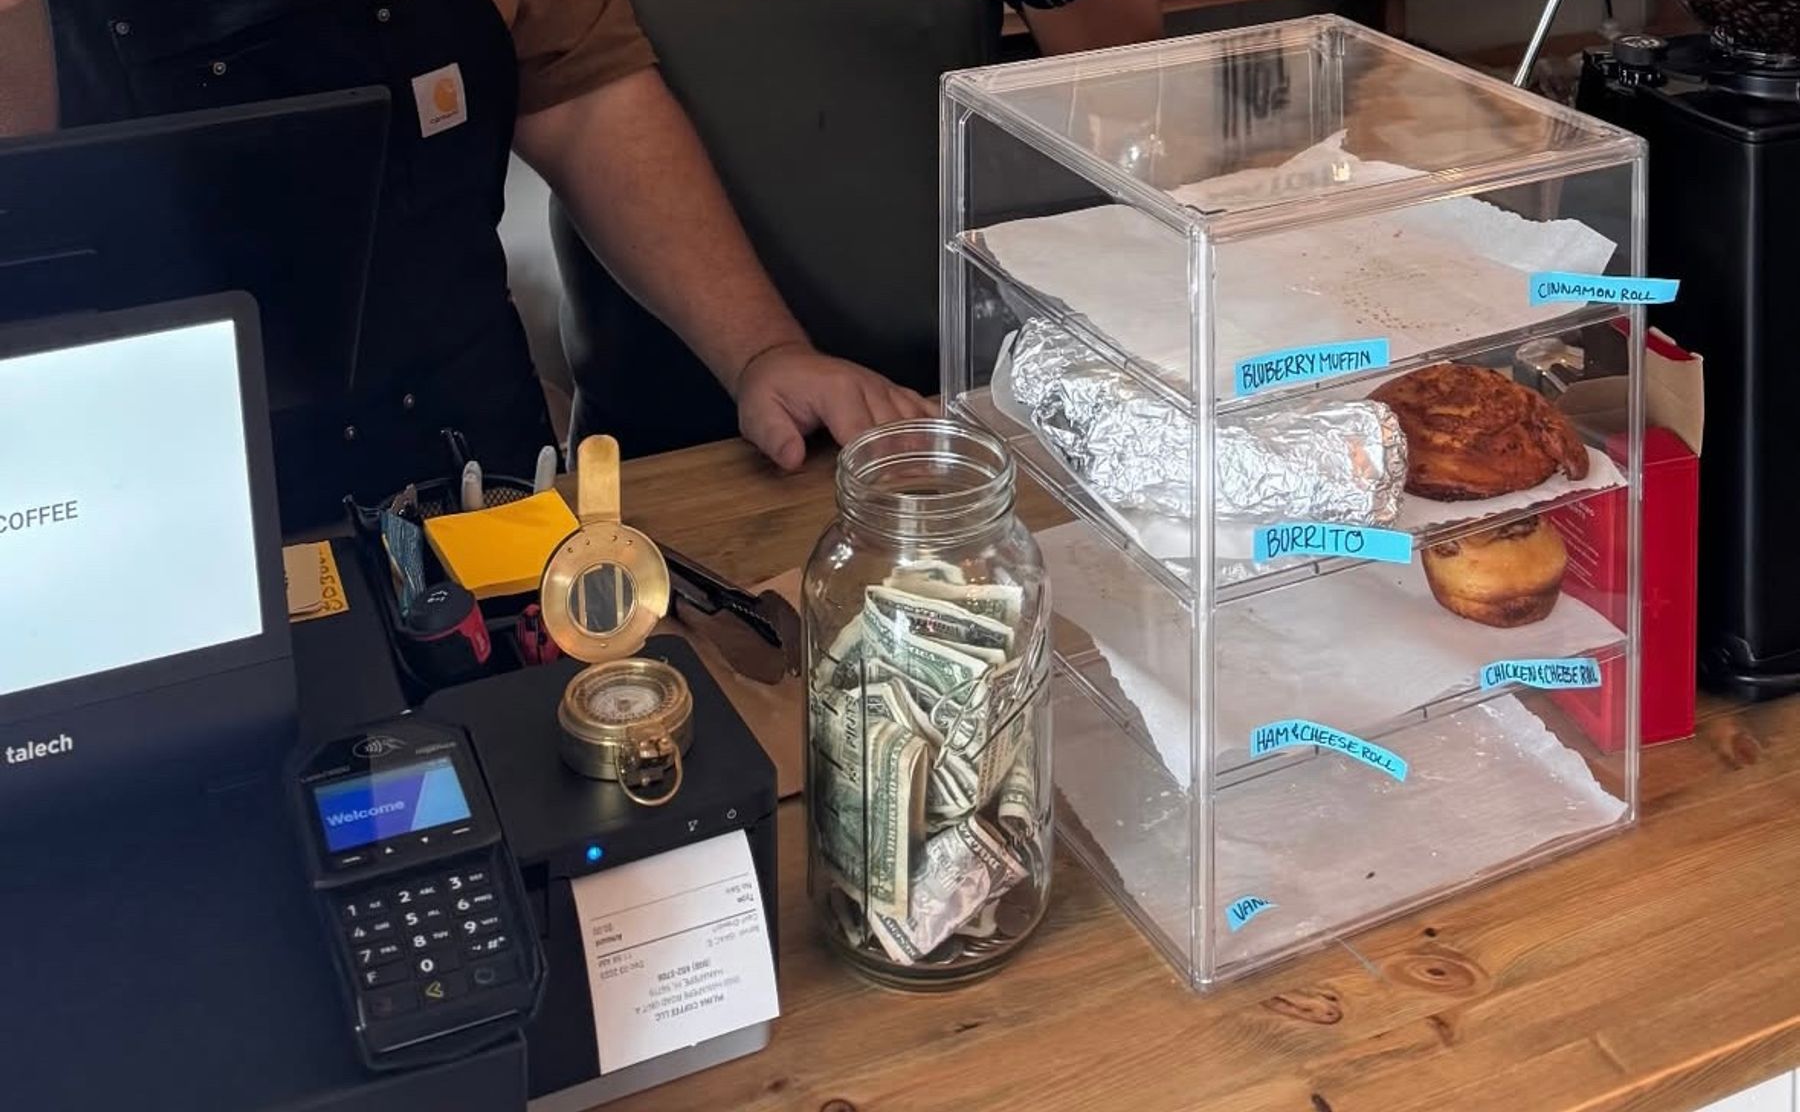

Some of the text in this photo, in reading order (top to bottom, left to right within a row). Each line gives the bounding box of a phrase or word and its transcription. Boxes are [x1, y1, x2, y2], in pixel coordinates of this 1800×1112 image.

[1537, 282, 1657, 302] CINNAMON ROLL
[1318, 350, 1372, 374] MUFFIN
[1266, 528, 1365, 559] BURRITO
[5, 733, 74, 764] talech
[1256, 726, 1289, 753] HAM
[1300, 725, 1359, 754] CHEESE
[1361, 745, 1396, 772] ROLL
[325, 799, 406, 827] Welcome
[448, 876, 462, 890] 3
[398, 890, 412, 904] 2
[457, 898, 471, 911] 6
[347, 904, 356, 917] 1
[405, 912, 418, 926] 5
[463, 920, 477, 935] 9
[413, 934, 427, 948] 8
[359, 948, 372, 963] 7
[420, 958, 434, 973] 0
[366, 971, 377, 984] F
